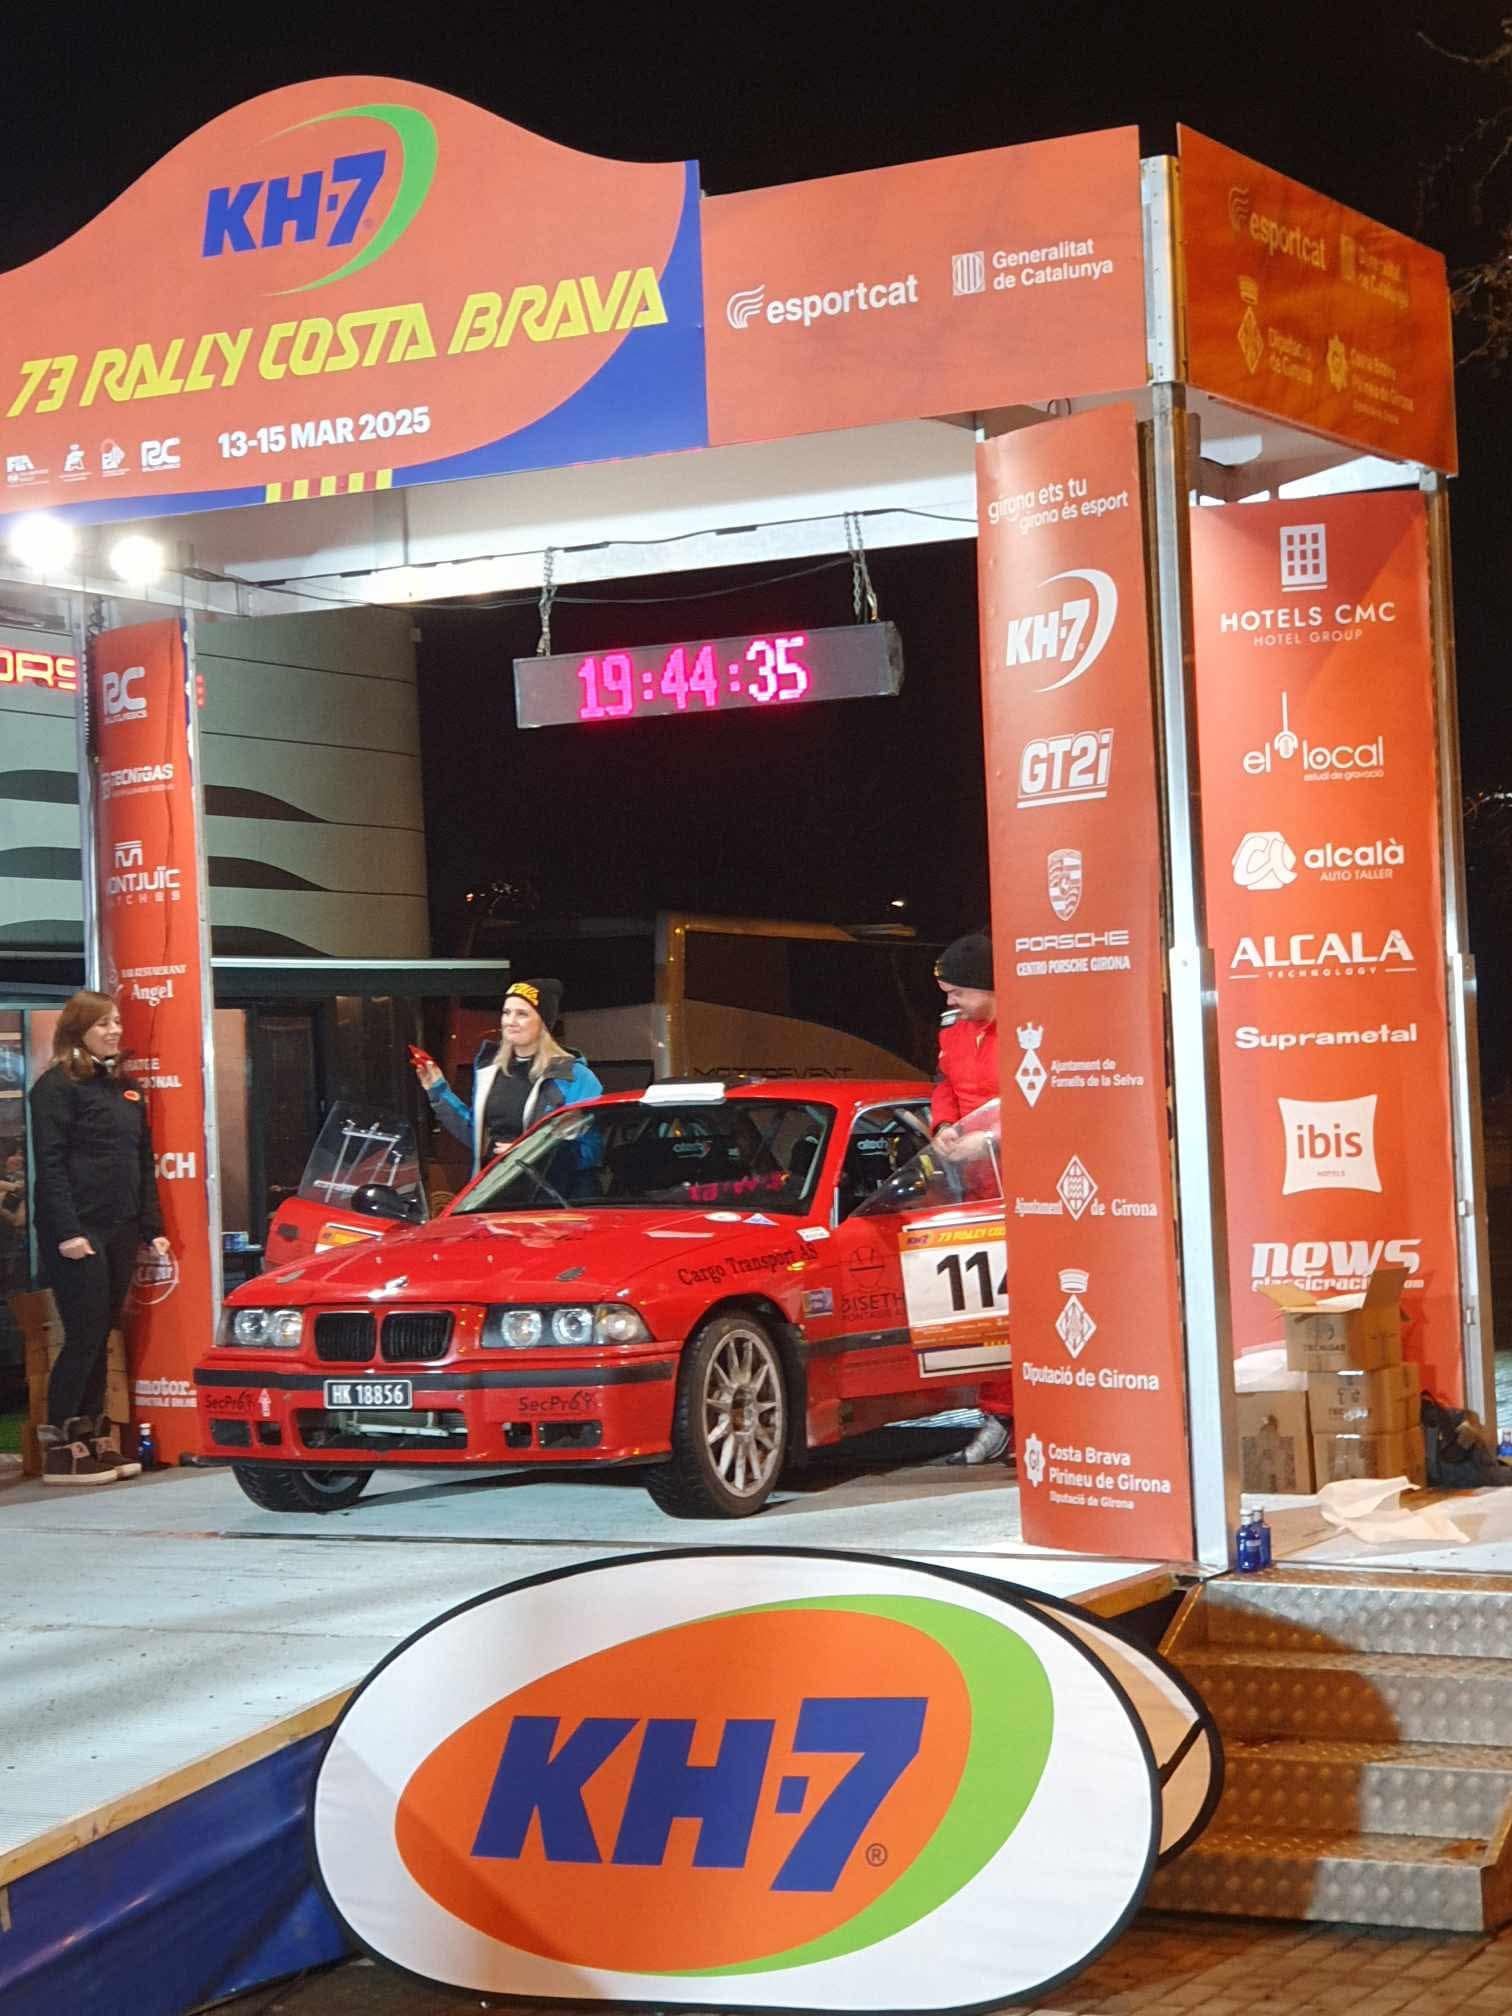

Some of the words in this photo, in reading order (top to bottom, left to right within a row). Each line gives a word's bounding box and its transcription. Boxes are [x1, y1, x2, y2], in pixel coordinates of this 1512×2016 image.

[992, 238, 1094, 269] Generalitat
[1250, 212, 1327, 271] esportcat
[993, 271, 1016, 291] de
[1020, 257, 1114, 286] Catalunya
[766, 273, 919, 327] esportcat
[7, 354, 77, 417] 73
[80, 328, 252, 407] RALLY
[259, 302, 436, 380] COSTA
[448, 266, 668, 354] BRAVA
[218, 426, 286, 458] 13-15
[291, 417, 354, 449] MAR
[359, 406, 431, 440] 2025
[988, 491, 1035, 524] girona
[1039, 483, 1064, 504] ets
[1068, 478, 1088, 498] tu
[1019, 509, 1058, 535] girona
[1062, 502, 1078, 519] és
[1081, 490, 1128, 517] esport
[1220, 606, 1323, 633] HOTELS
[1334, 601, 1397, 625] CMC
[1253, 632, 1300, 647] HOTEL
[1309, 629, 1363, 644] GROUP
[578, 636, 808, 719] 19:44:35
[1021, 731, 1112, 793] GT2i
[1242, 742, 1271, 774] el
[1302, 735, 1384, 770] local
[1303, 837, 1405, 870] alcalà
[1320, 869, 1352, 882] AUTO
[1354, 867, 1393, 880] TALLER
[1016, 930, 1129, 952] PORSCHE
[1267, 967, 1377, 979] TECHNOLOGY
[1235, 1023, 1417, 1050] Suprametal
[1087, 1075, 1099, 1087] de
[1101, 1074, 1111, 1086] la
[1113, 1073, 1144, 1087] Selva
[1102, 1059, 1116, 1070] de
[1296, 1123, 1363, 1160] ibis
[1090, 1199, 1105, 1216] de
[1111, 1199, 1158, 1217] Girona
[677, 1264, 726, 1285] Cargo
[724, 1246, 795, 1274] Transport
[1252, 1239, 1423, 1278] news
[1022, 1362, 1072, 1386] Diputació
[1075, 1368, 1096, 1387] de
[1099, 1368, 1159, 1391] Girona
[332, 1385, 352, 1404] HK
[355, 1384, 403, 1405] 18856
[1048, 1443, 1082, 1463] Costa
[1085, 1446, 1131, 1467] Brava
[1049, 1467, 1092, 1488] Pirineu
[1095, 1471, 1115, 1490] de
[1117, 1472, 1171, 1494] Girona
[1087, 1493, 1098, 1507] de
[1100, 1494, 1134, 1511] Girona
